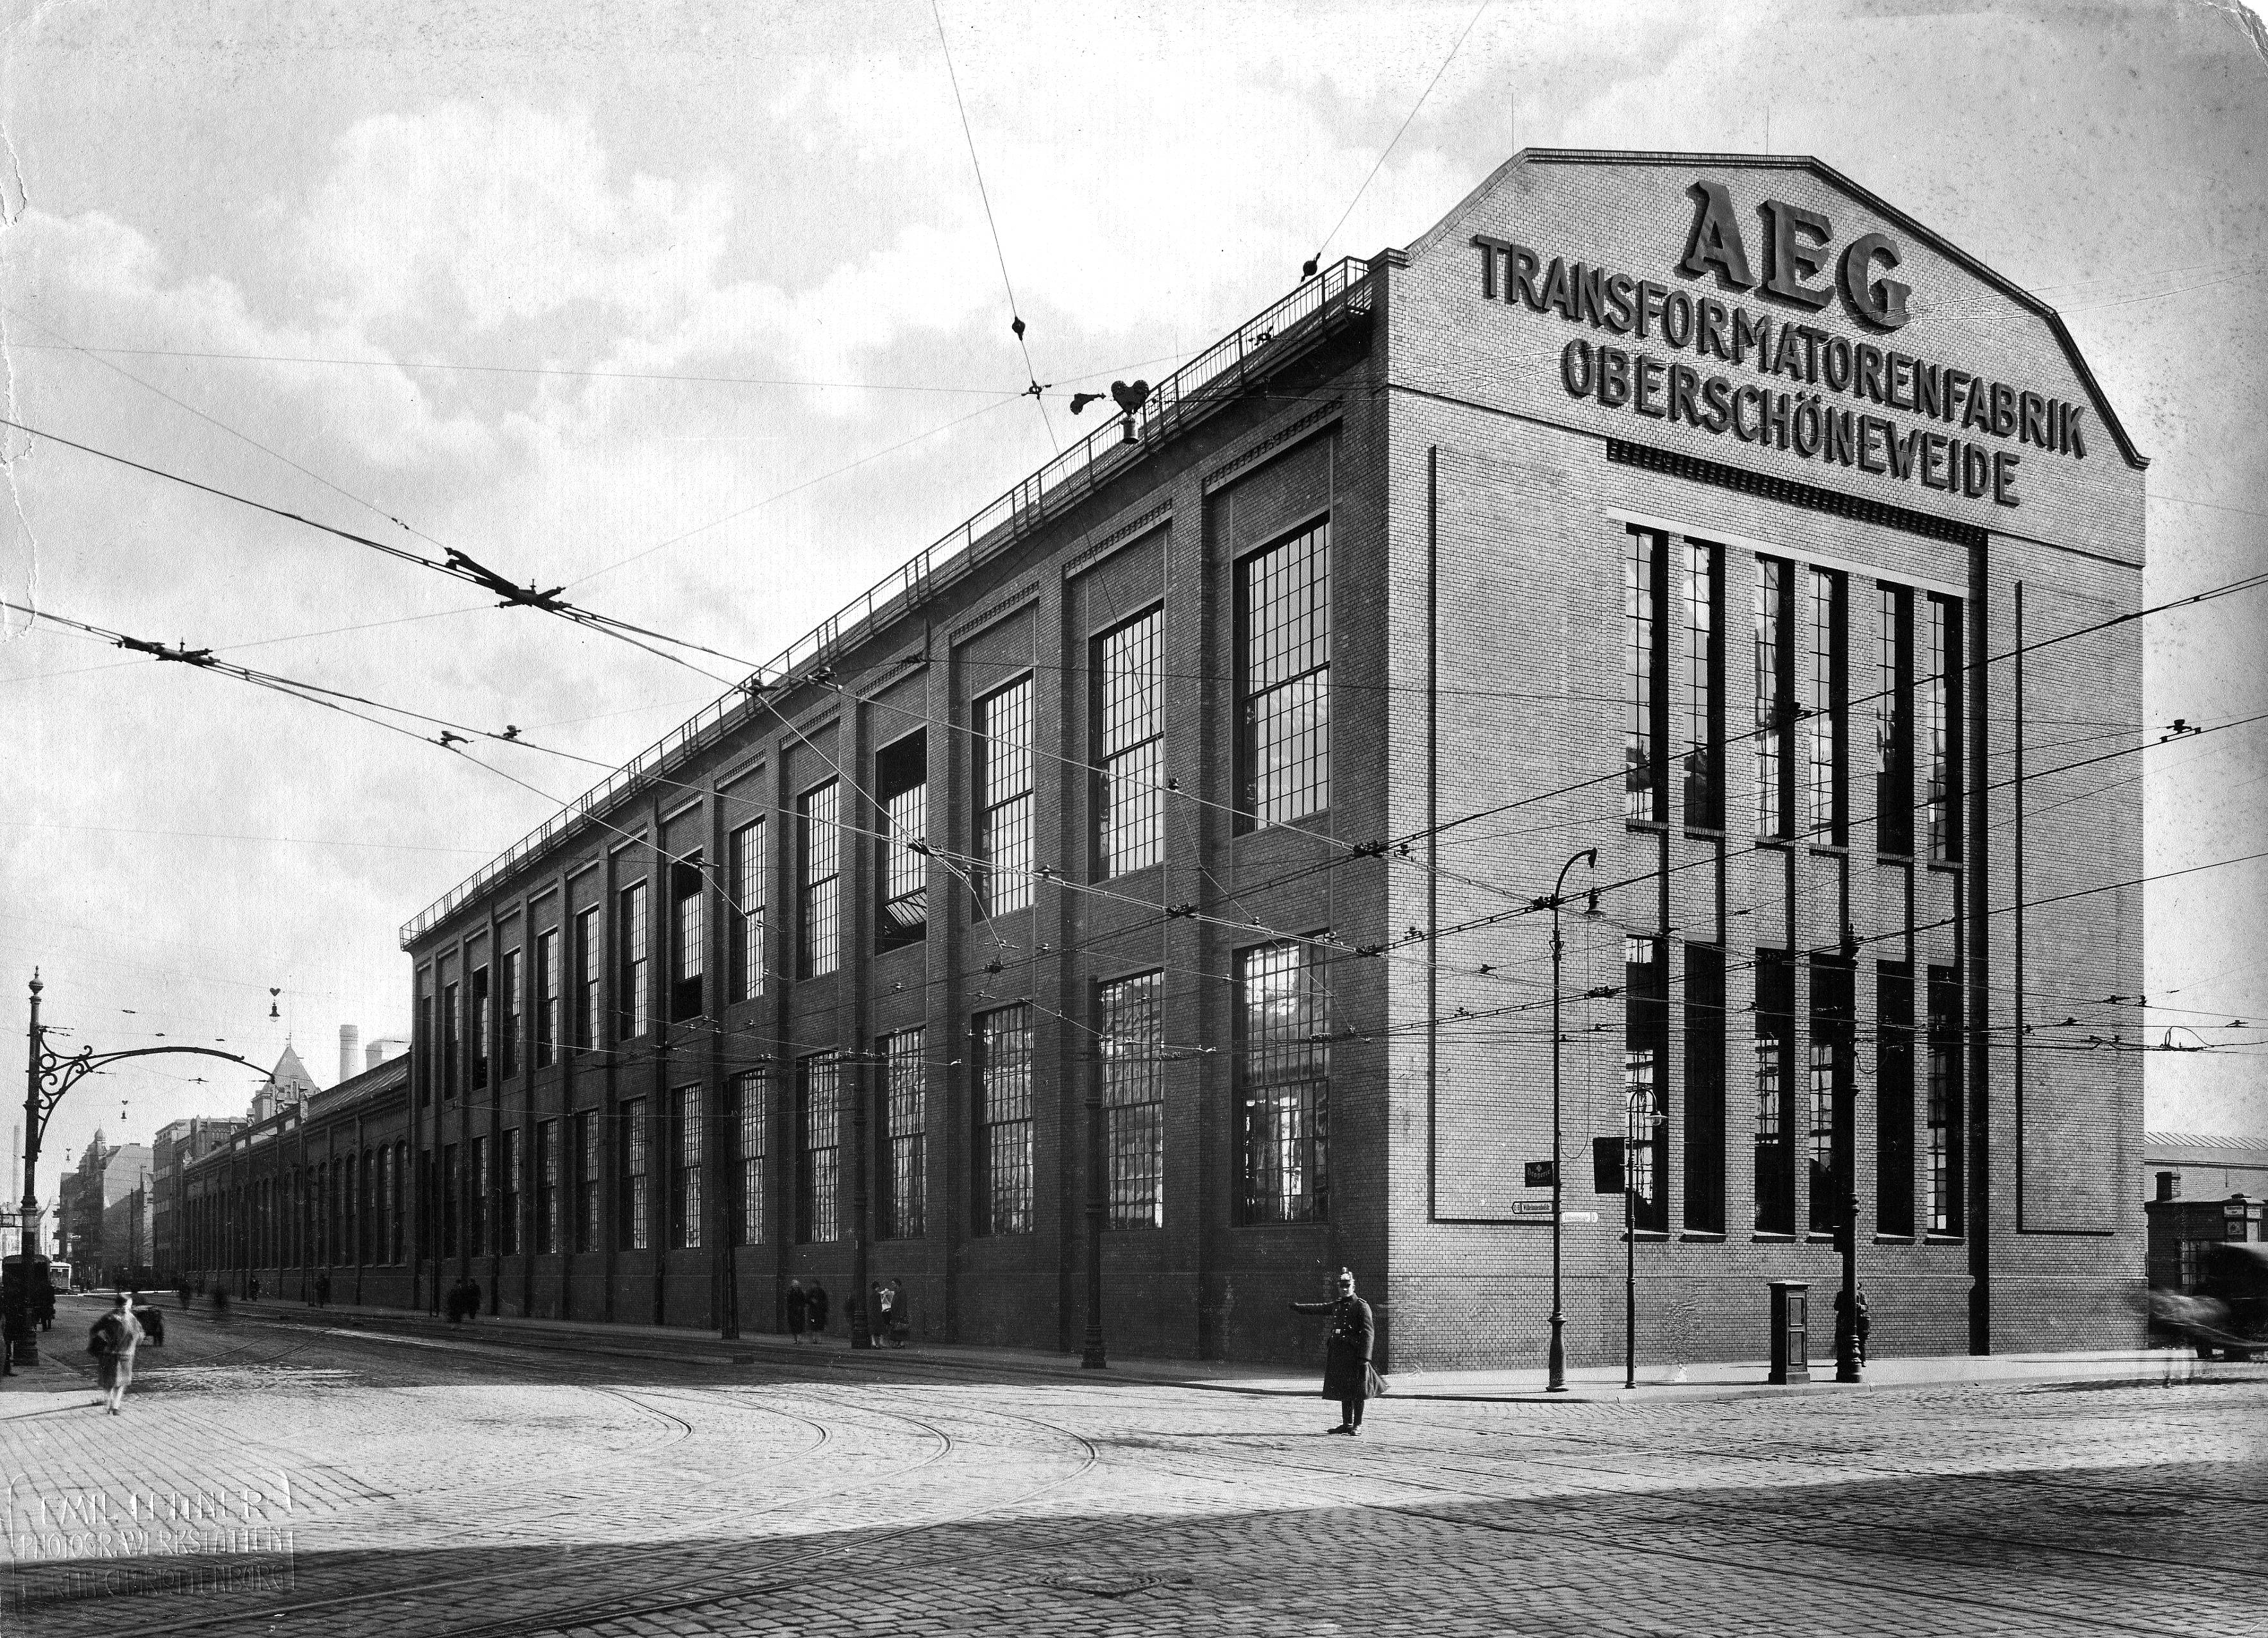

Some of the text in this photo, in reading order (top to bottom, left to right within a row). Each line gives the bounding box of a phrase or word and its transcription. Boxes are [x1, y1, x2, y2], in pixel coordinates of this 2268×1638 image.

[1675, 180, 1915, 330] AEG
[1471, 234, 2087, 459] TRANSFORMATORENFABRIK
[1561, 337, 2021, 507] OBERSCHÖNEWEIDE
